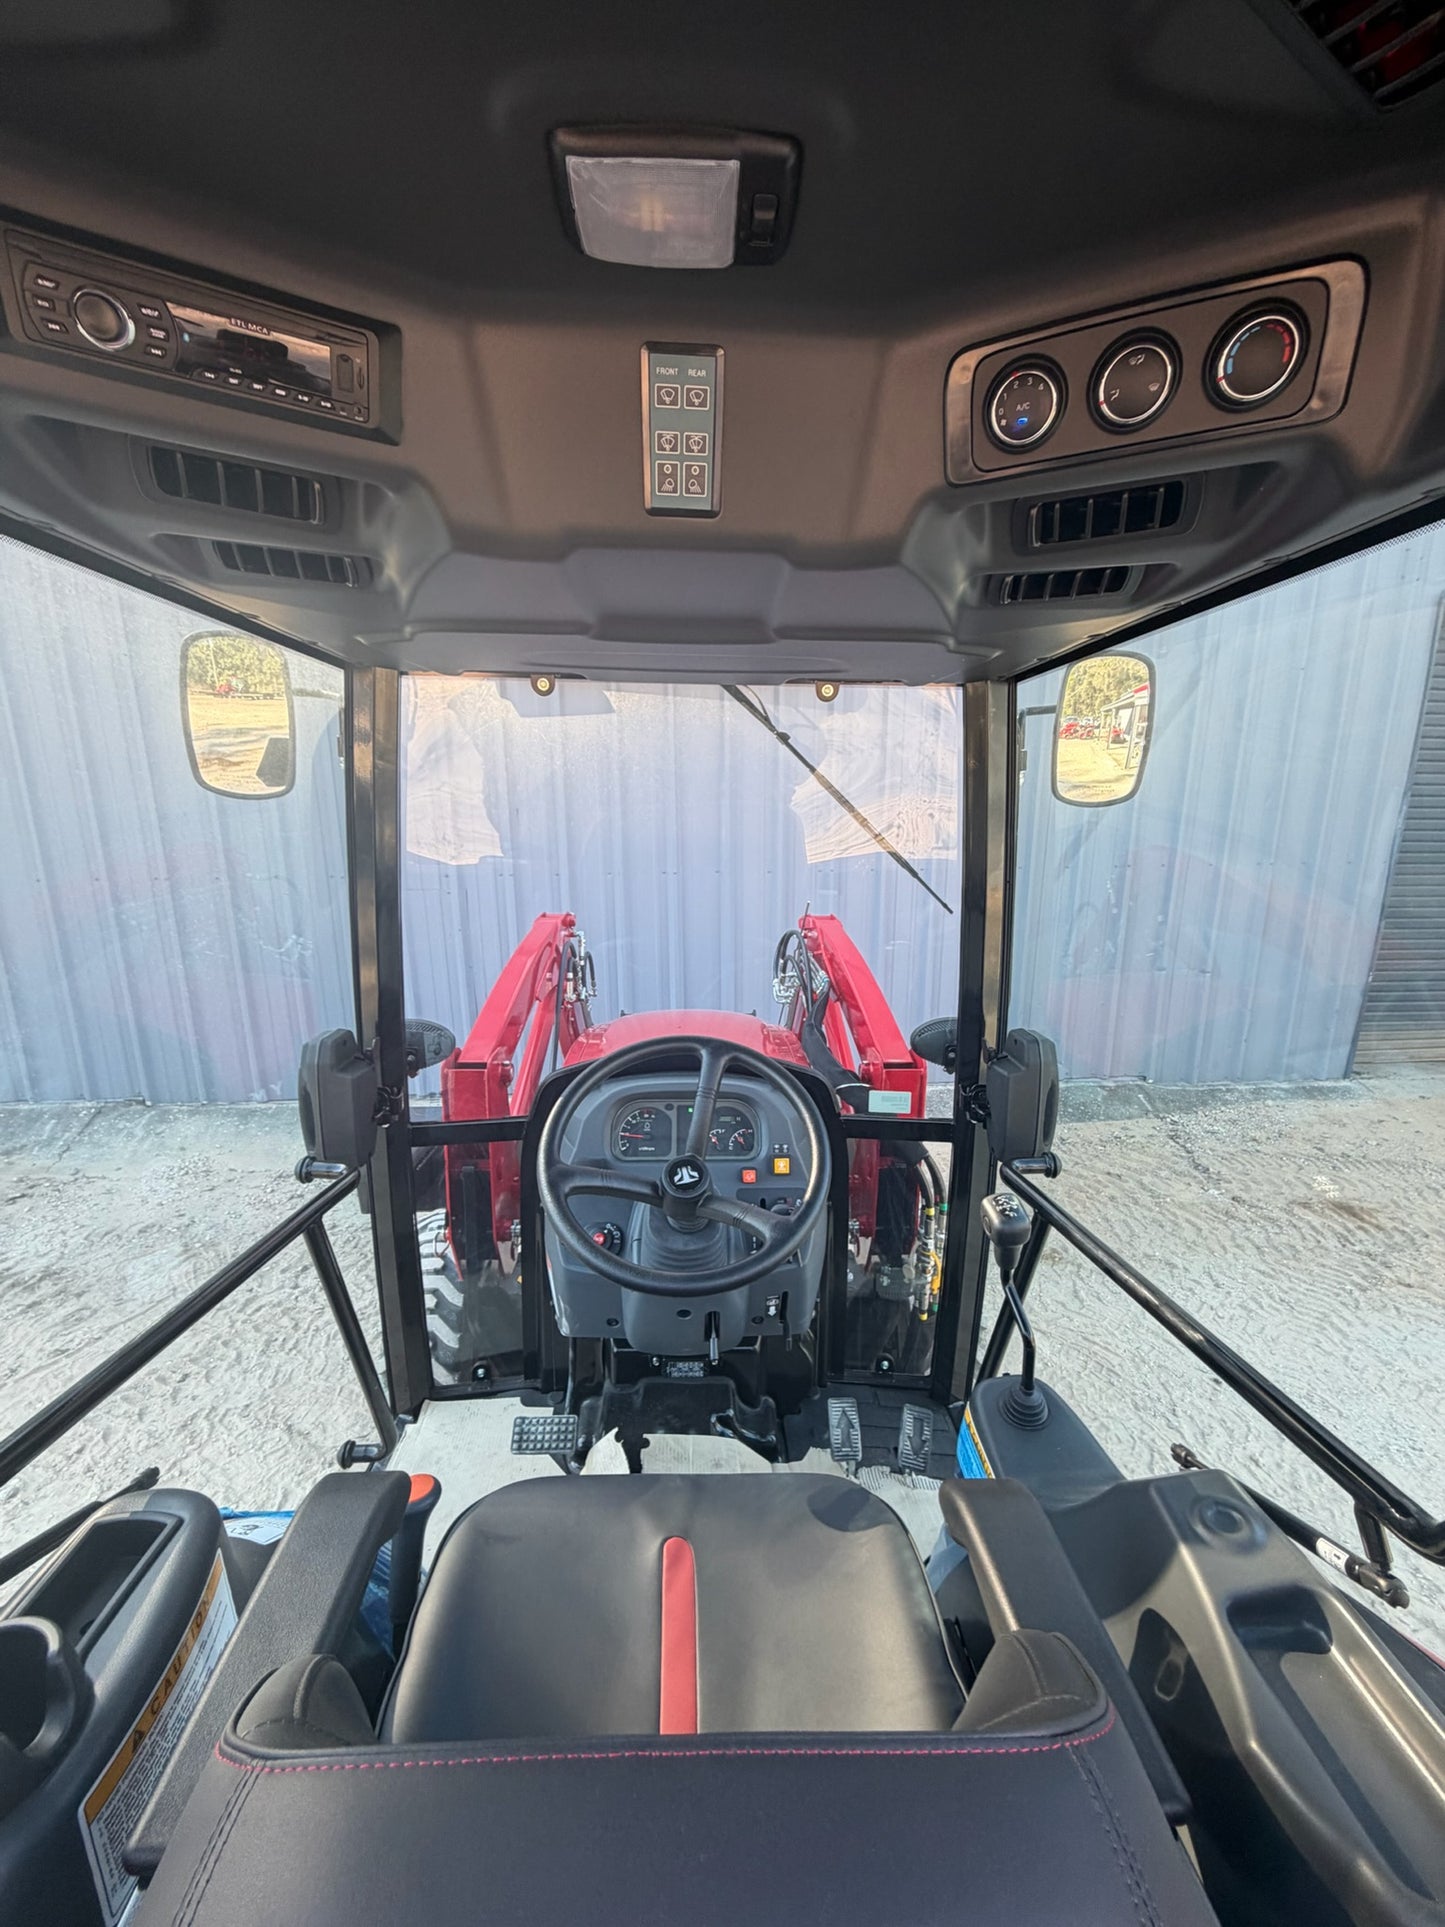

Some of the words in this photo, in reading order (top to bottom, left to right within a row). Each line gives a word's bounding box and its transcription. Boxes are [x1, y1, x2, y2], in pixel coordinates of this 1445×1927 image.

[656, 367, 678, 376] FRONT
[688, 368, 707, 377] REAR
[1015, 402, 1030, 411] A/C
[150, 1597, 211, 1716] CAUTION
